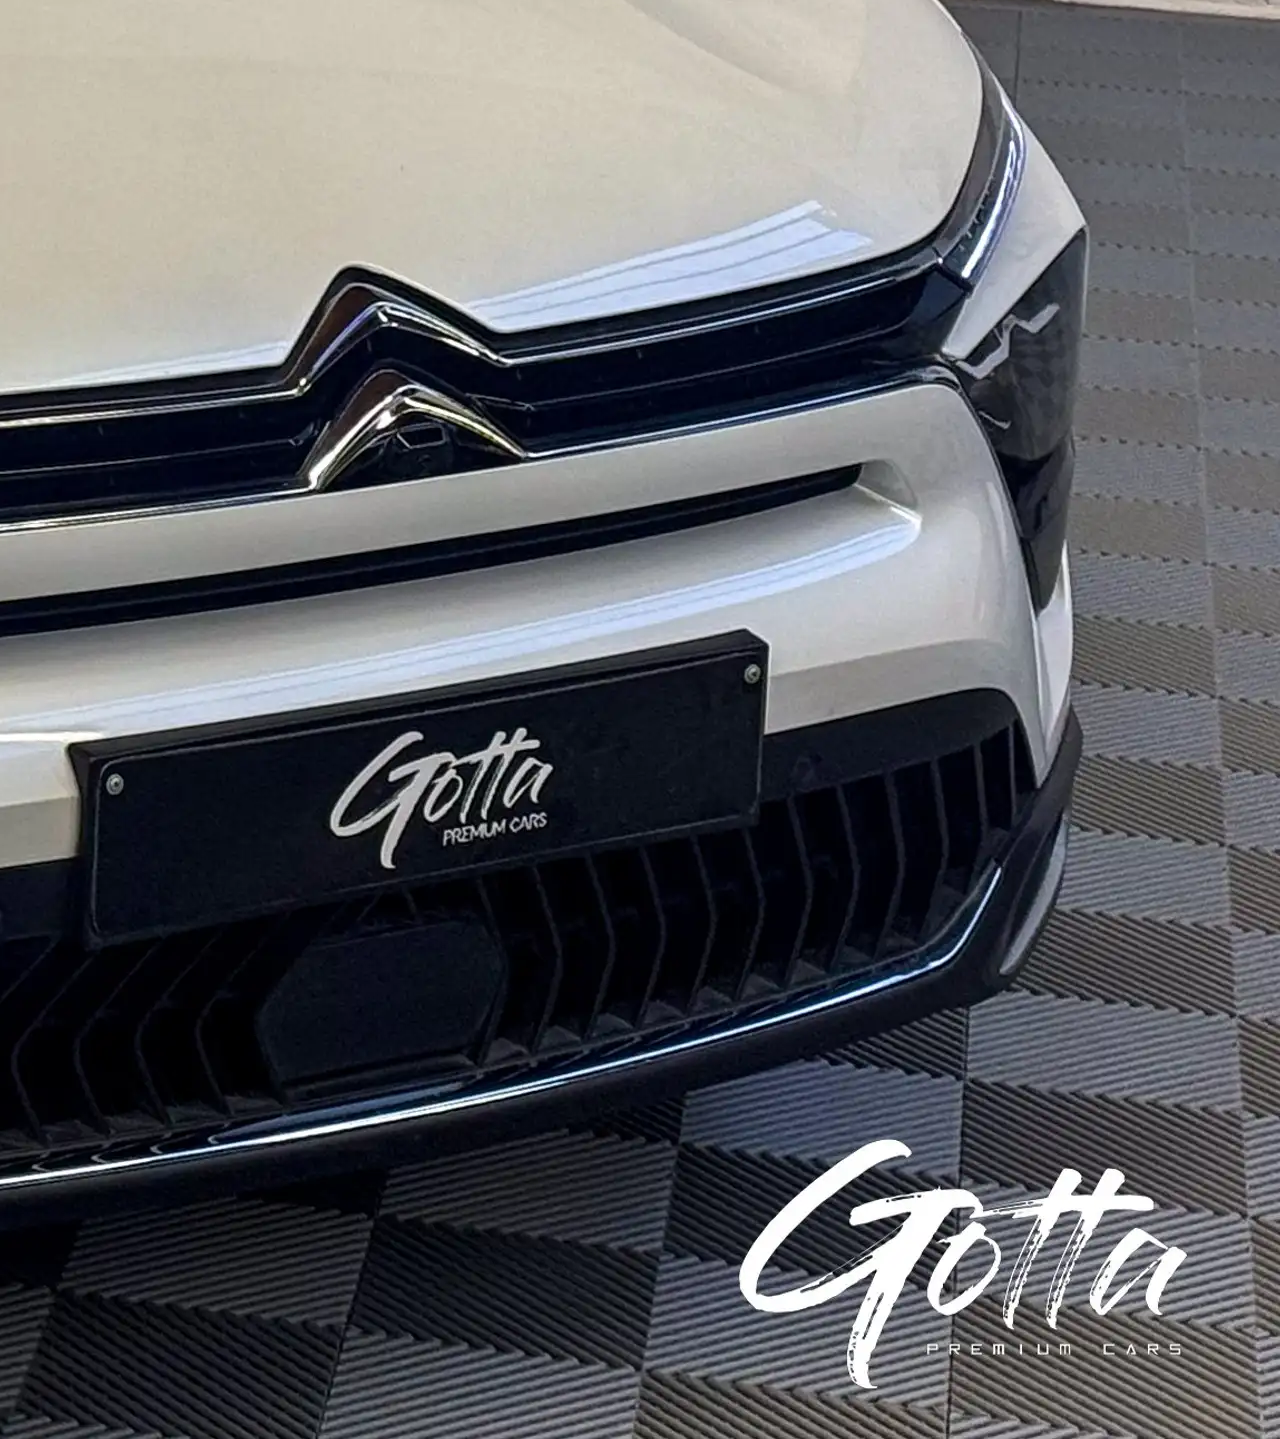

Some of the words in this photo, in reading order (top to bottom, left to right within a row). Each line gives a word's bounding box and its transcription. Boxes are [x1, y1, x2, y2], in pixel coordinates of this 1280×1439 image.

[330, 727, 554, 869] Gotta
[442, 818, 507, 847] PREMIUM
[508, 811, 548, 834] CARS
